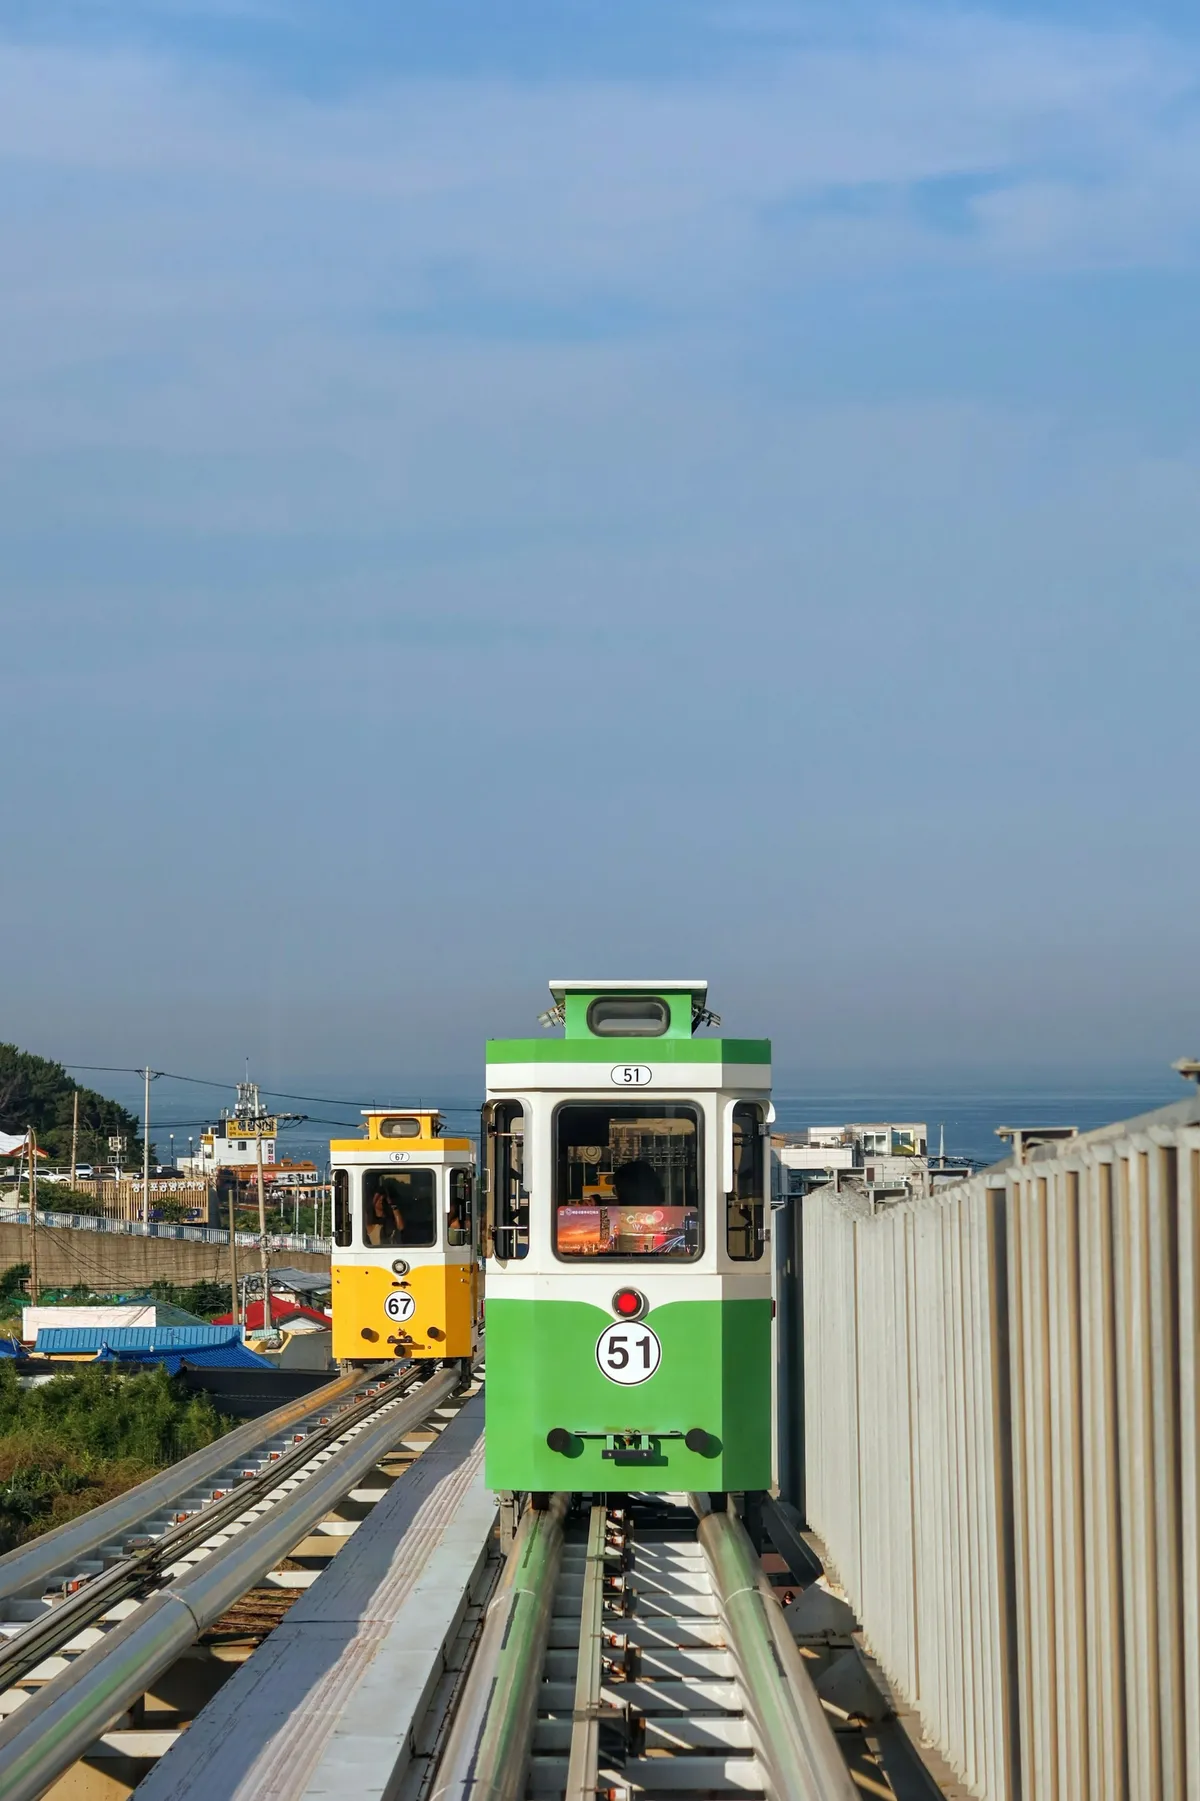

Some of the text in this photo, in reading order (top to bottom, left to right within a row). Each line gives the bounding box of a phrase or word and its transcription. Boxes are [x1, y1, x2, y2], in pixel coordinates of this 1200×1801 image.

[623, 1068, 640, 1083] 51
[394, 1152, 405, 1161] 67
[388, 1298, 412, 1315] 67
[607, 1336, 651, 1370] 51
